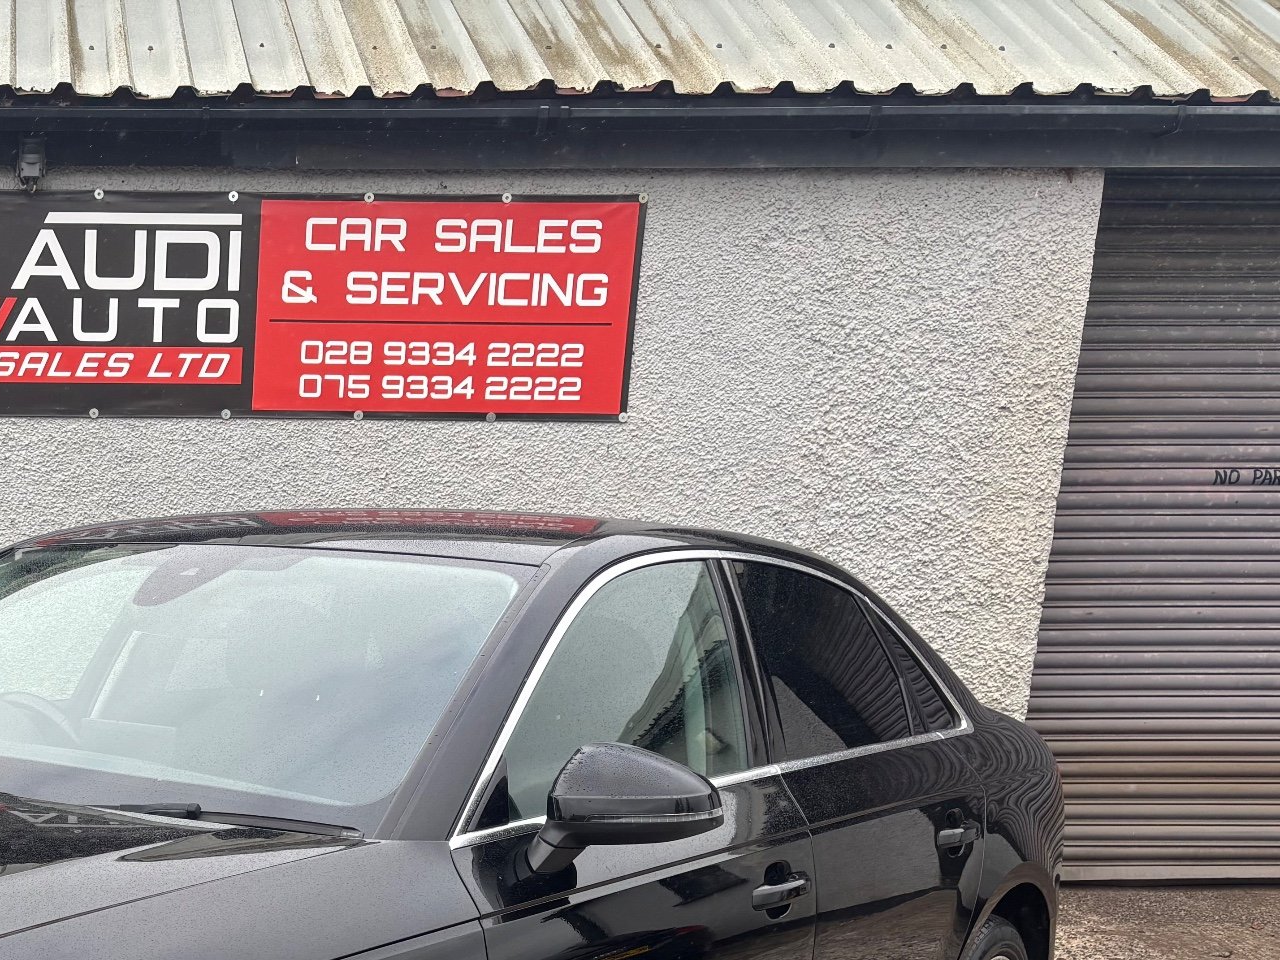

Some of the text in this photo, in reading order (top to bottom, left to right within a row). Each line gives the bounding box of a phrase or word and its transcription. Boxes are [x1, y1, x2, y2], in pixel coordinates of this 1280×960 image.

[304, 217, 603, 254] CAR SALES
[10, 229, 242, 292] AUDI
[281, 270, 609, 307] & SERVICING
[5, 298, 240, 344] AUTO
[147, 352, 231, 379] LTD
[300, 340, 585, 368] 028 9334 2222
[298, 374, 583, 401] 075 9334 2222
[1212, 468, 1241, 486] NO
